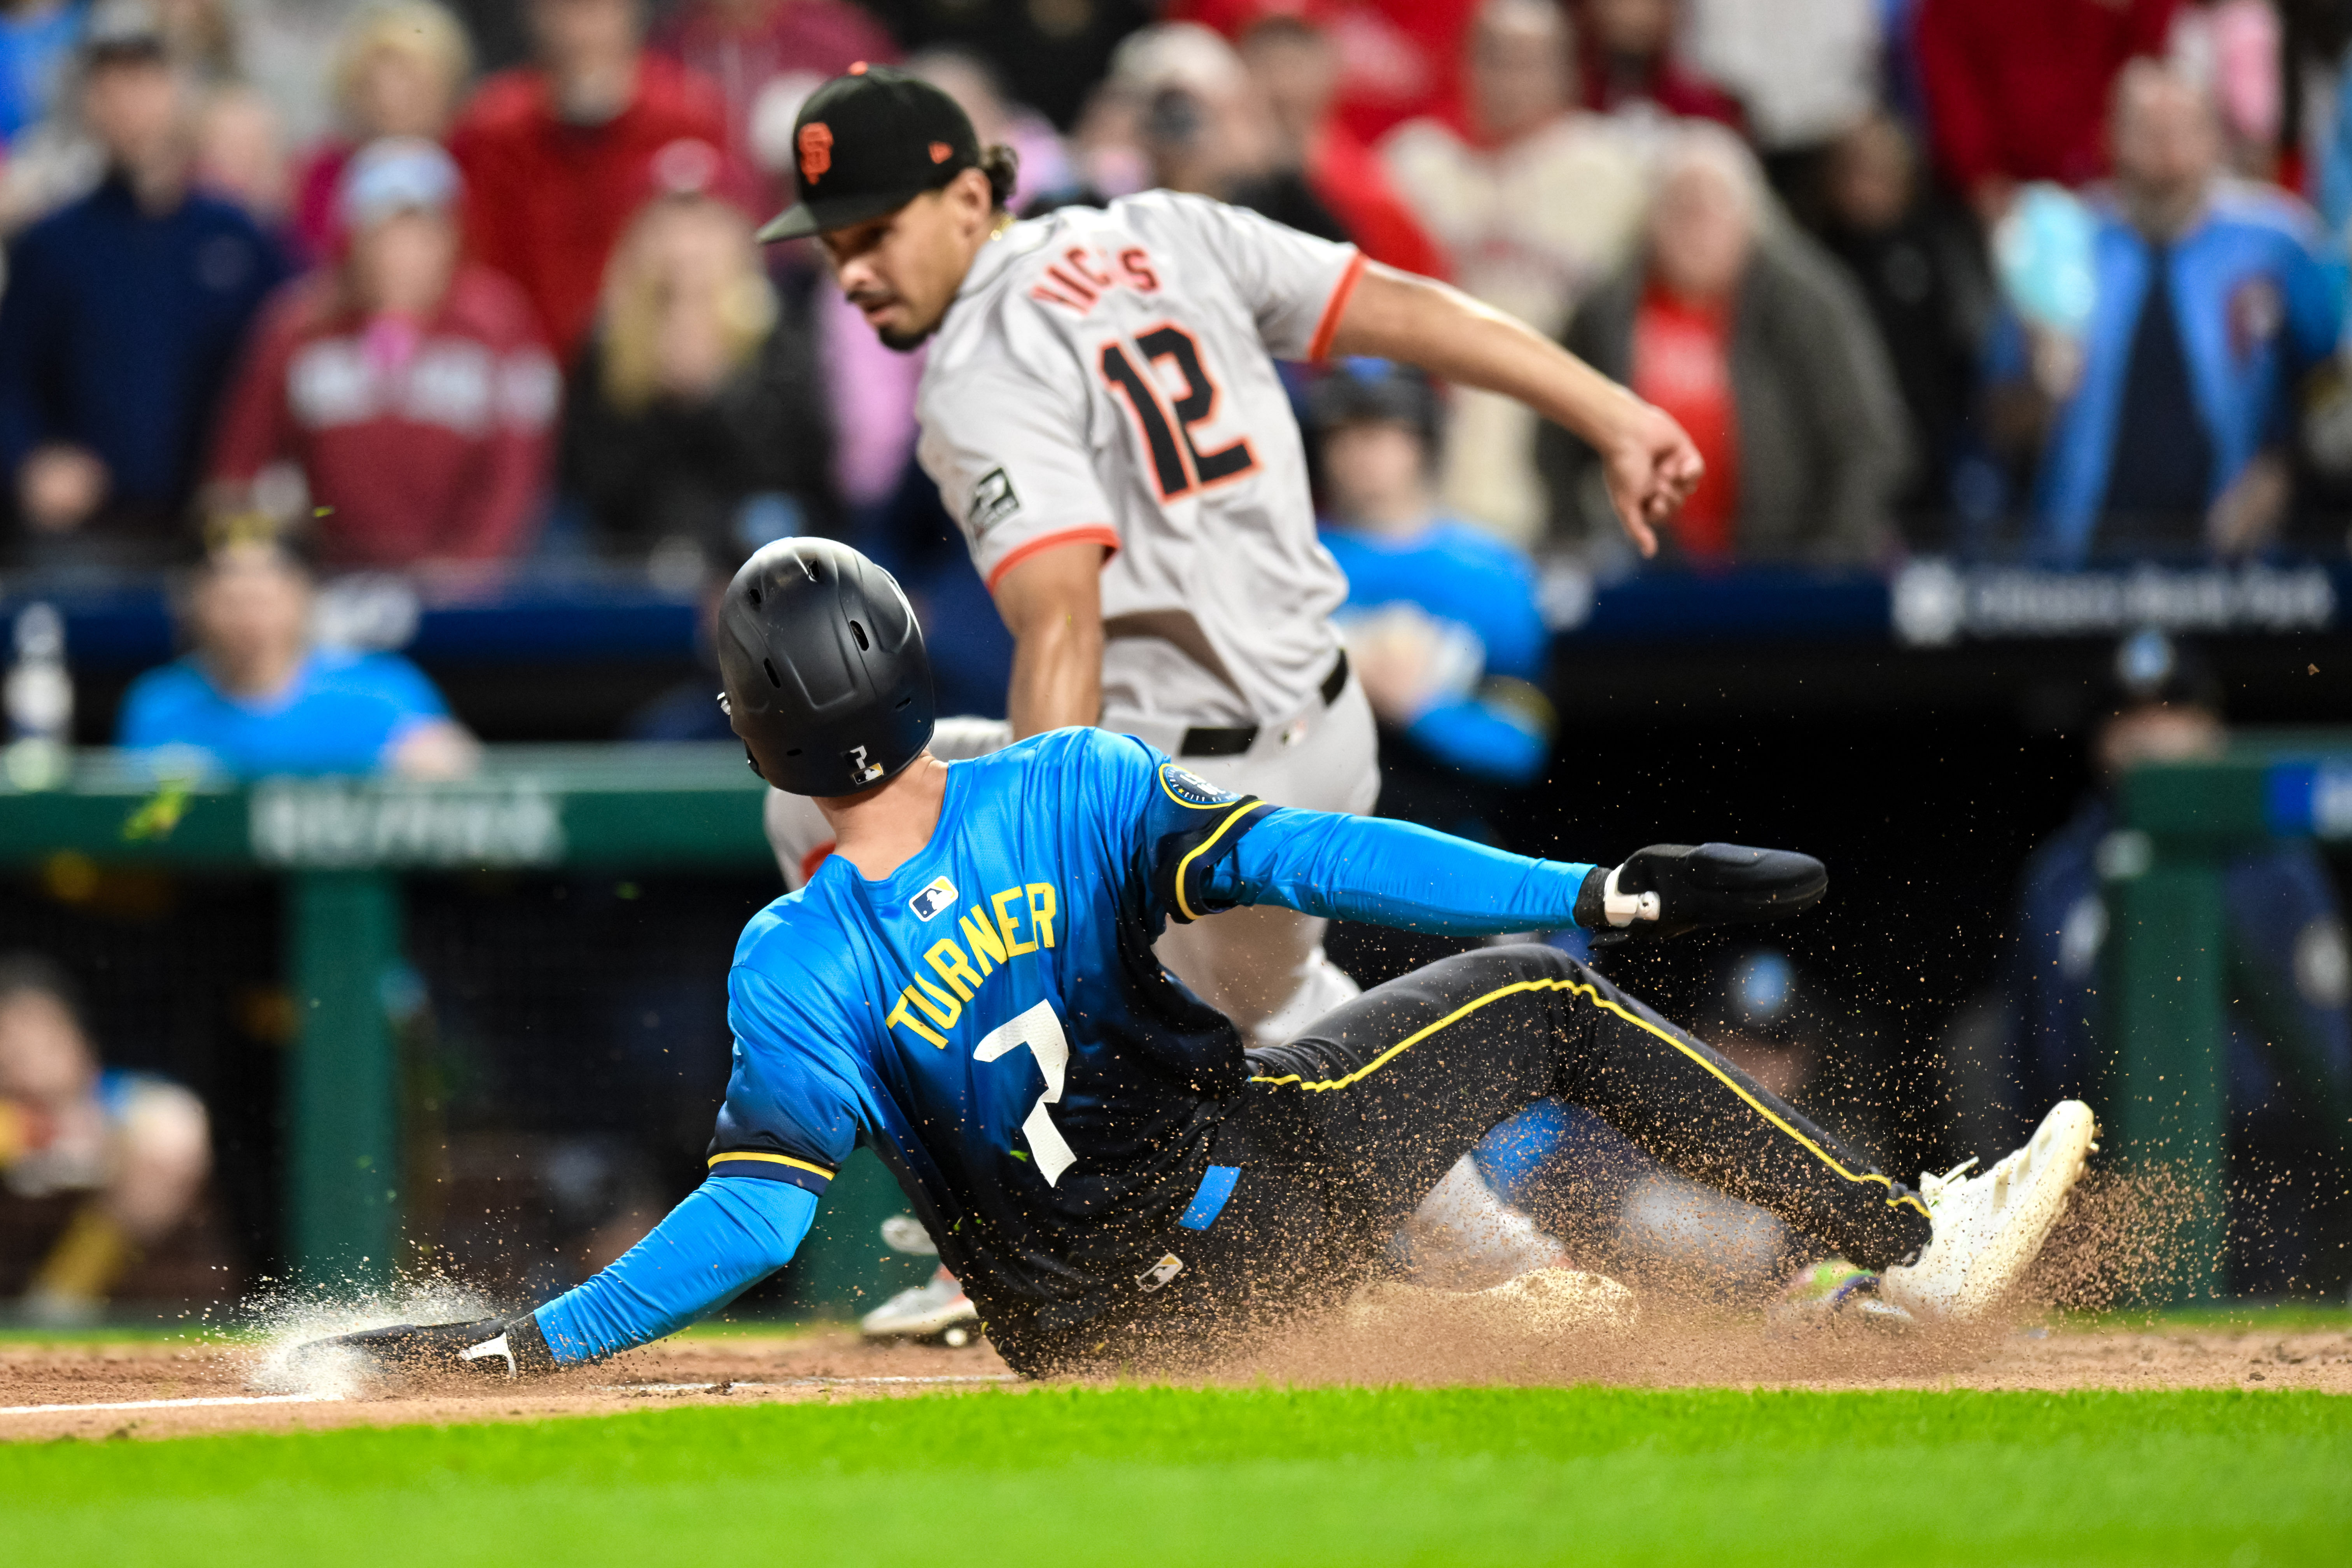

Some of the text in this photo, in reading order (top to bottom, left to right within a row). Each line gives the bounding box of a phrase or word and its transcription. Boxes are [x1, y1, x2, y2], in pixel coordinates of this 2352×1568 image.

[1095, 318, 1264, 506] 12
[886, 882, 1056, 1049] TURNER
[973, 998, 1077, 1188] 7
